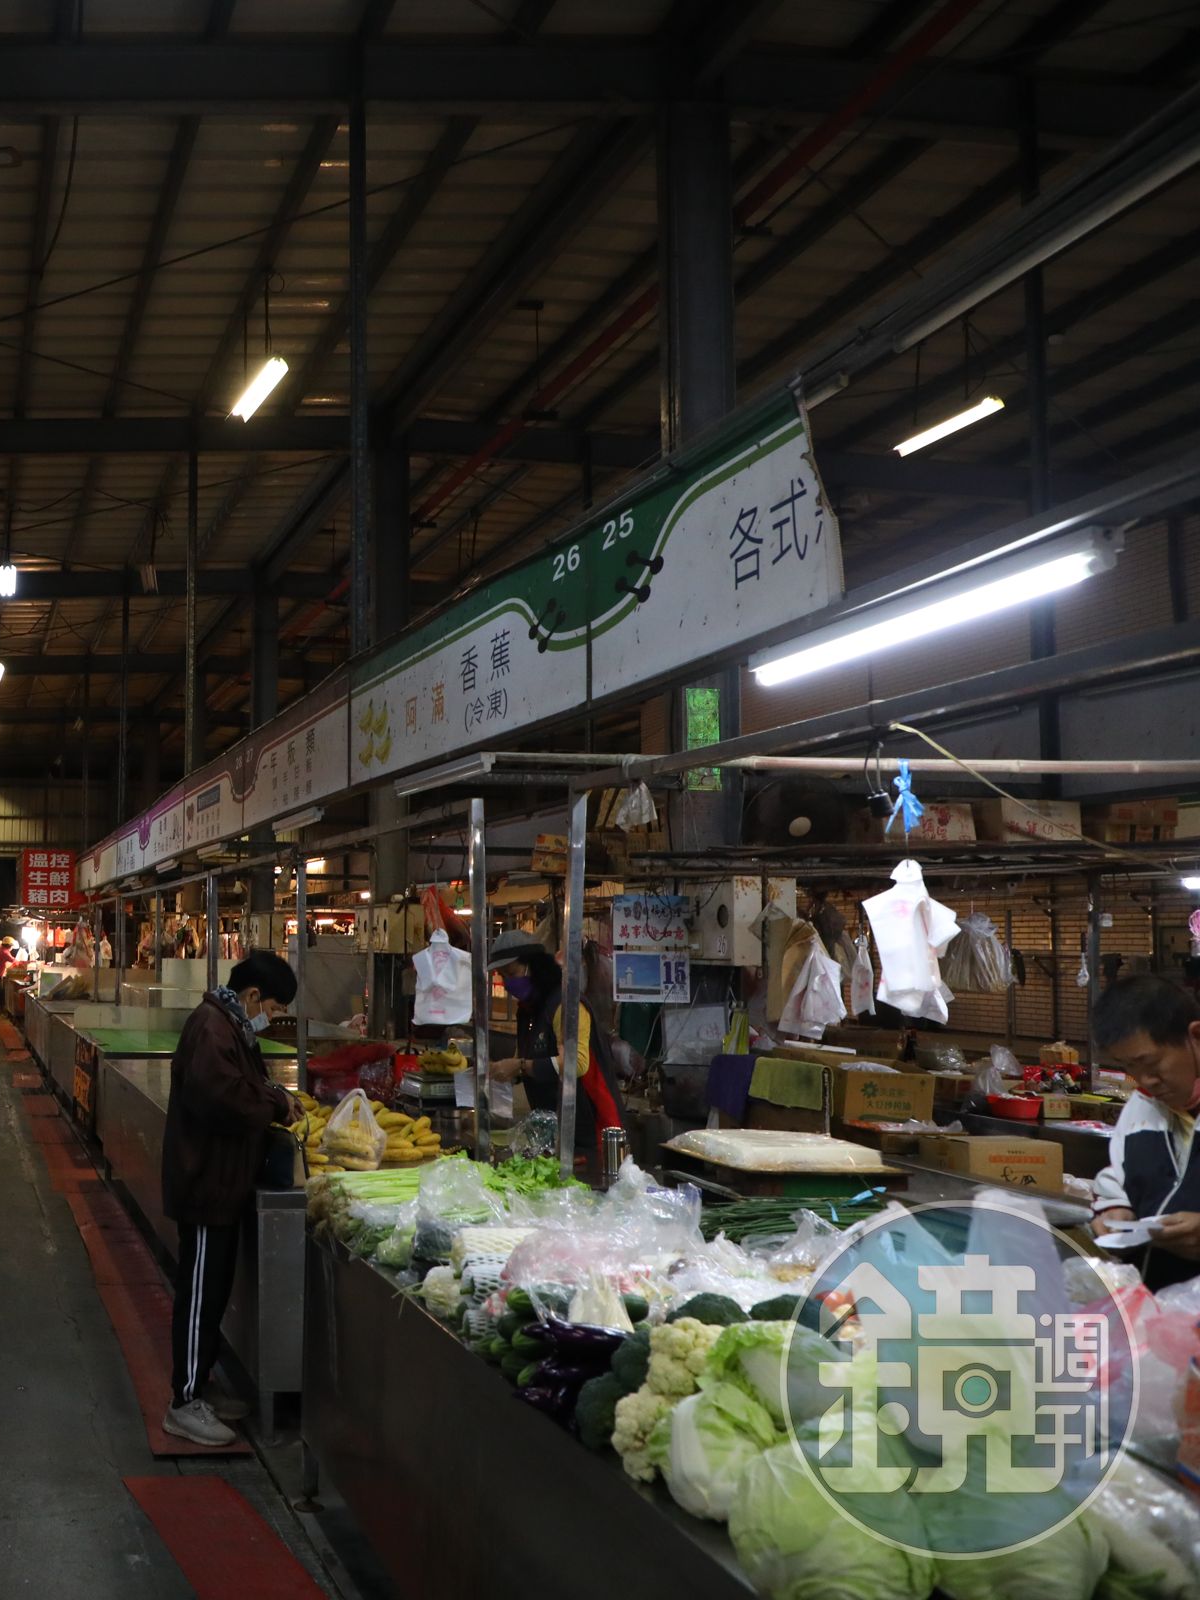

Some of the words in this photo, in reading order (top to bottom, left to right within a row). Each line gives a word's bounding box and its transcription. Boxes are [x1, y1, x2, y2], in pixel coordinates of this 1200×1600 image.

[602, 508, 635, 551] 25
[729, 477, 823, 590] 各式
[552, 544, 581, 582] 26
[460, 628, 511, 695] 香蕉
[405, 680, 446, 736] 阿滿
[28, 871, 70, 887] 生鮮
[28, 889, 70, 904] 豬肉
[663, 961, 687, 985] 15
